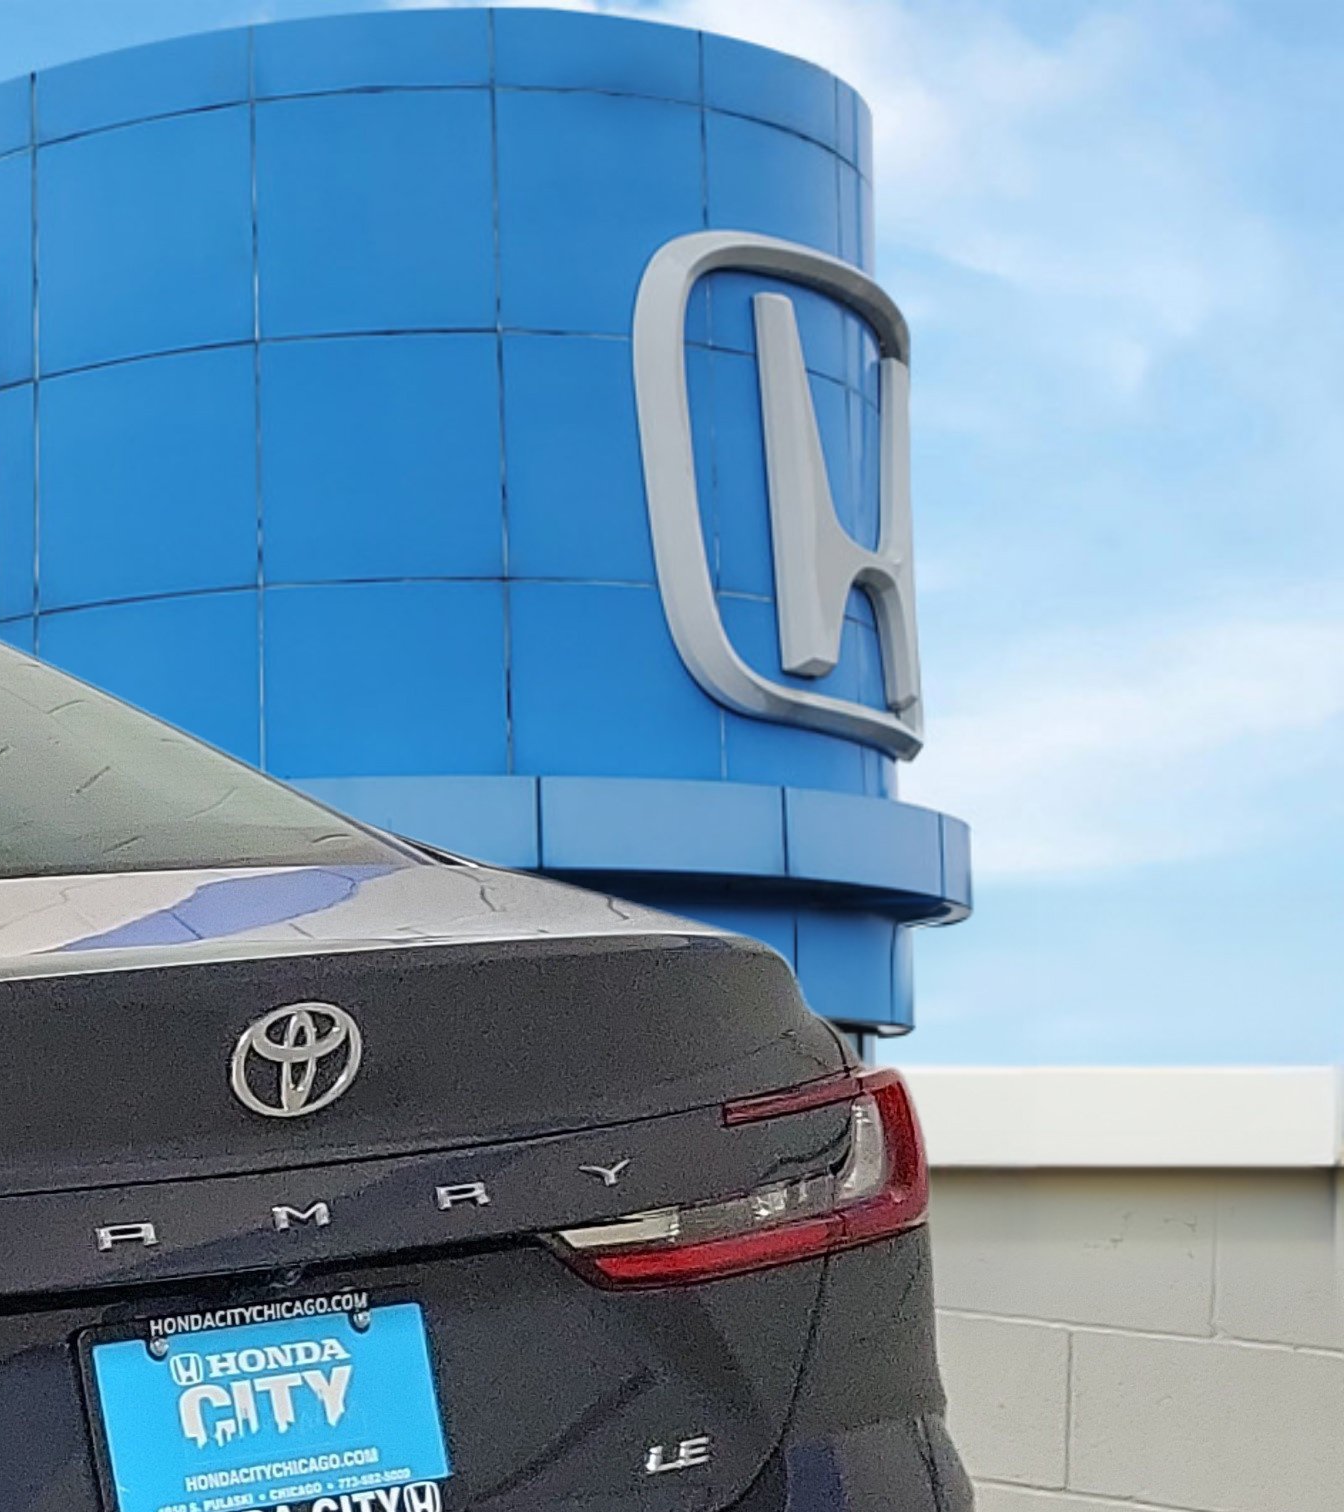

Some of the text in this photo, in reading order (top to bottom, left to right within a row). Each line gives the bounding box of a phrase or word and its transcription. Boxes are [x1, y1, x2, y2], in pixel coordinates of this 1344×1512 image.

[149, 1292, 369, 1337] HONDACITYCHICAGO.COM
[208, 1338, 350, 1377] HONDA
[178, 1364, 354, 1449] CITY
[185, 1446, 380, 1493] HONDACITYCHICAGO.COM
[645, 1436, 710, 1474] LE
[269, 1482, 323, 1501] CHICAGO
